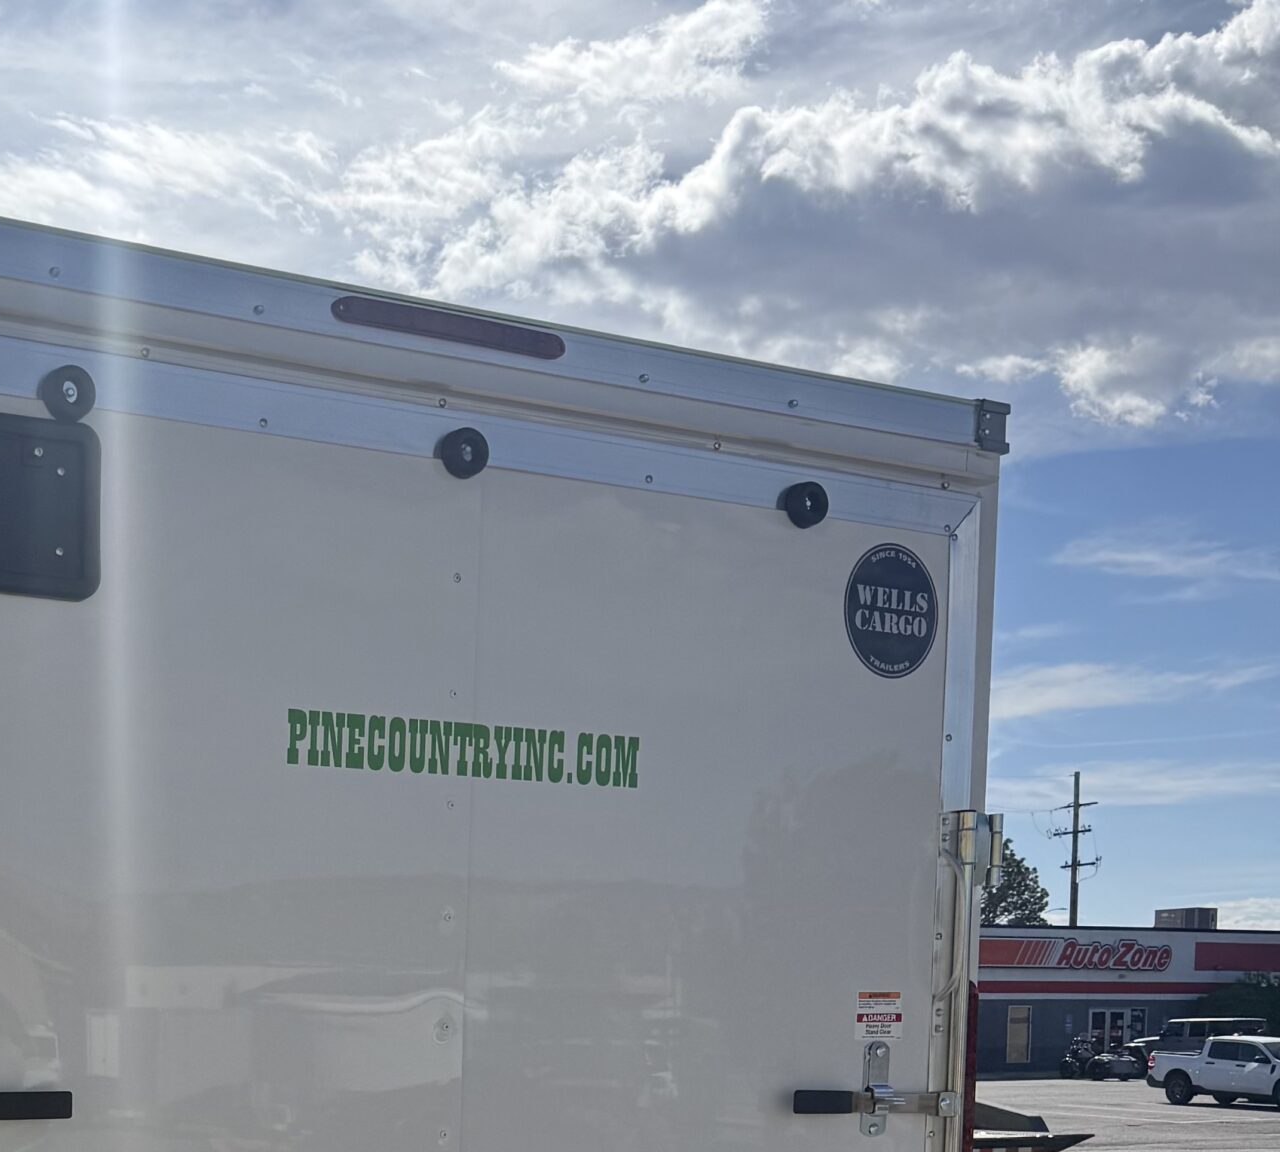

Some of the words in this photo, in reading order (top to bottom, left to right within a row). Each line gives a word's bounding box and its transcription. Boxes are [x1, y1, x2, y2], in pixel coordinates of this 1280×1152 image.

[871, 550, 896, 563] SINCE
[857, 584, 929, 614] WELLS
[855, 609, 928, 638] CARGO
[869, 655, 910, 672] TRAILERS
[287, 708, 640, 788] PINECOUNTRYINC.COM
[868, 1014, 897, 1022] DANGER
